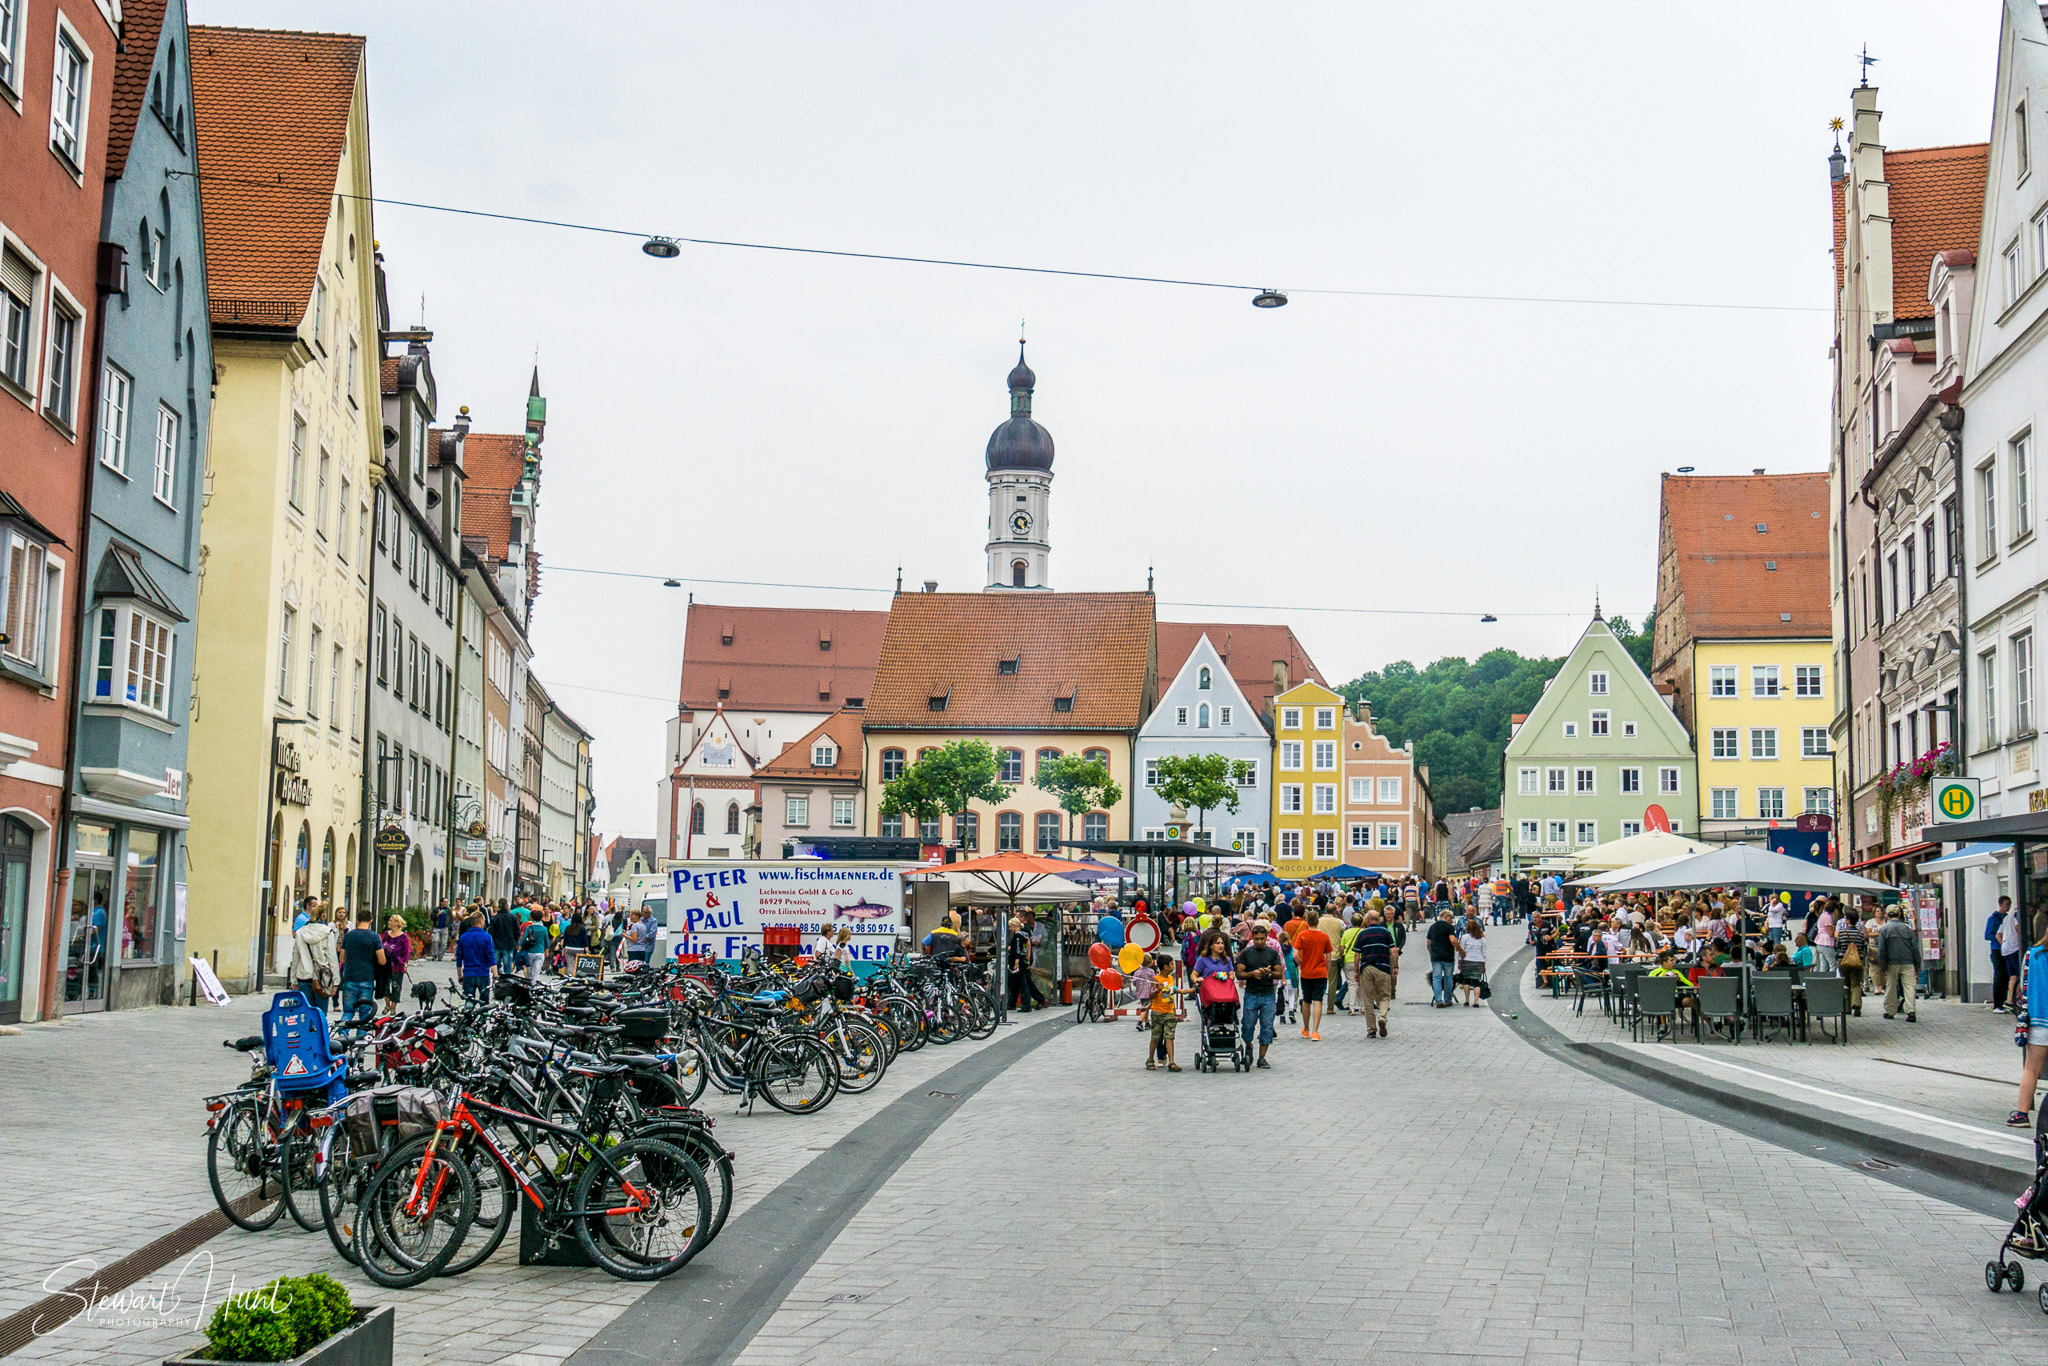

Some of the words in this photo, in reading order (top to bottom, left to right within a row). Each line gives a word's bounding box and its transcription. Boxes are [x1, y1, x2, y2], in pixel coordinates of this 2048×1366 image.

[1949, 791, 1964, 812] H
[1511, 846, 1575, 854] HOFPFISTEREI
[821, 888, 828, 896] &
[829, 888, 840, 896] Co
[842, 888, 854, 896] KG
[705, 891, 721, 909] &
[800, 924, 809, 932] 98
[810, 924, 820, 933] 50
[856, 924, 865, 933] 98
[867, 924, 877, 933] 50
[878, 924, 888, 933] 97
[889, 924, 895, 933] 6
[482, 1128, 531, 1187] BULLS
